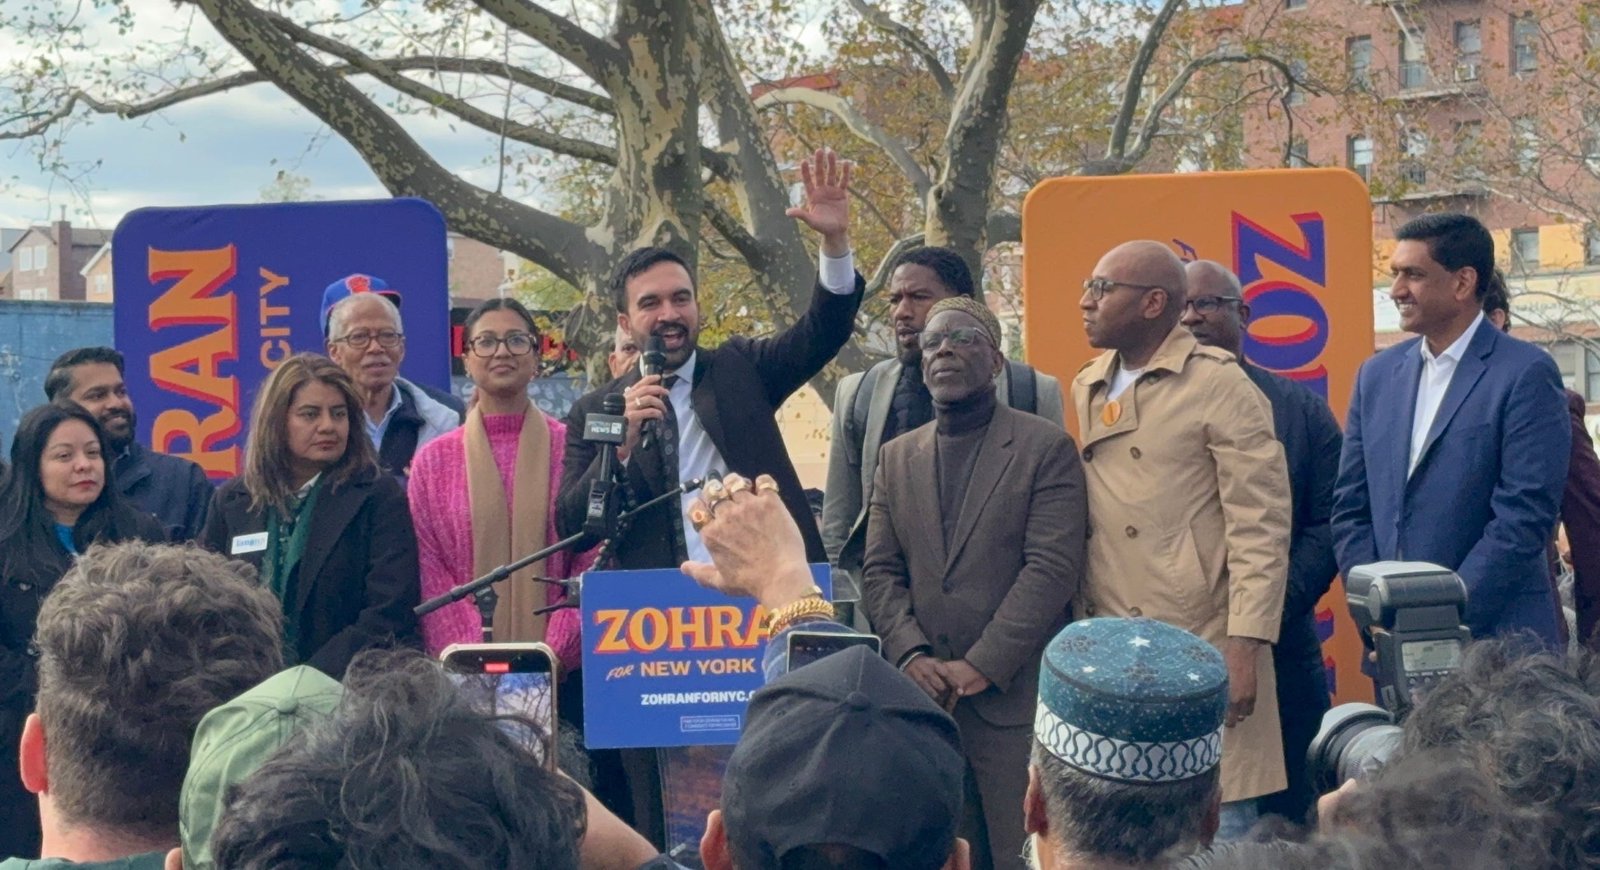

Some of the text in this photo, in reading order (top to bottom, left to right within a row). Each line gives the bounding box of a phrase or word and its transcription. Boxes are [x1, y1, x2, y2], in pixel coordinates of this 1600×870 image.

[148, 244, 240, 478] RAN
[259, 267, 291, 369] CITY
[606, 658, 756, 681] FOR NEW YORK
